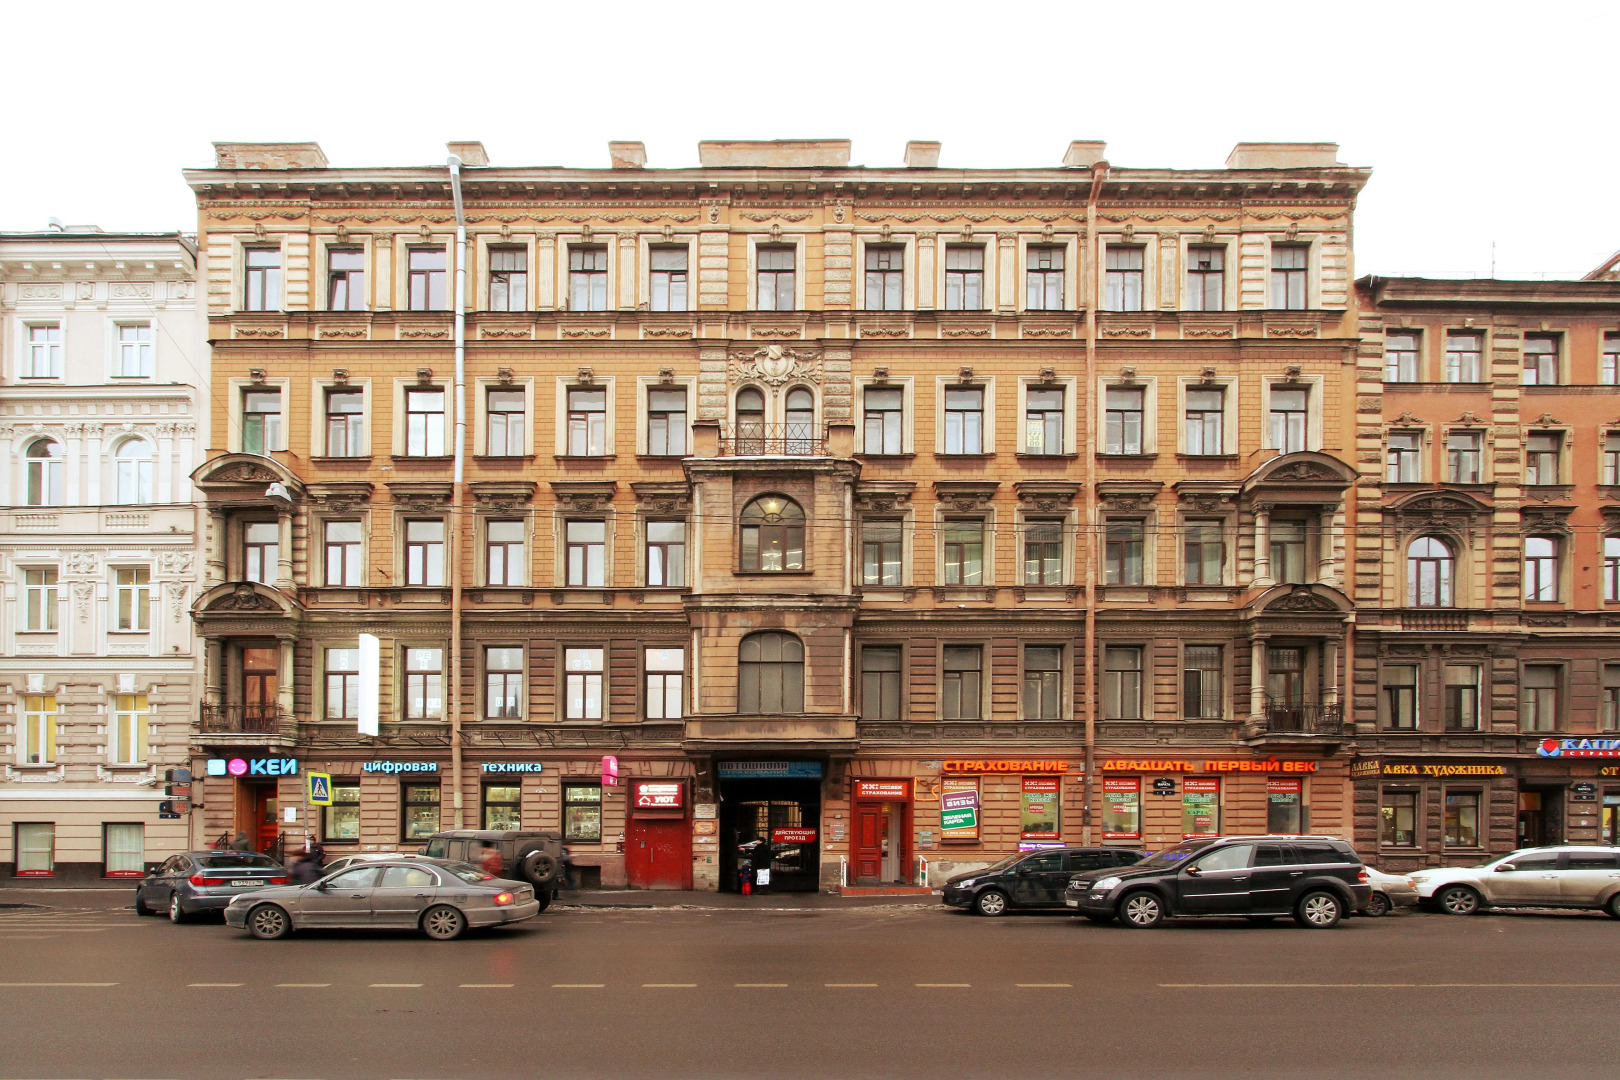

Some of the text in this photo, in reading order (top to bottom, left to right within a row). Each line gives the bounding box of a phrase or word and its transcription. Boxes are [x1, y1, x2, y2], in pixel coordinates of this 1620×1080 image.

[250, 758, 298, 775] КЕЙ
[363, 760, 438, 774] цифровая
[481, 763, 543, 773] техника
[719, 762, 788, 770] АВТОШКОЛА
[942, 760, 1068, 771] СТРАХОВАНИЕ
[1102, 757, 1317, 772] ДВАДЦАТЬ ПЕРВЫЙ ВЕК
[1383, 764, 1505, 777] АВКА ХУДОЖНИКА
[946, 799, 975, 807] ВИЗЫ
